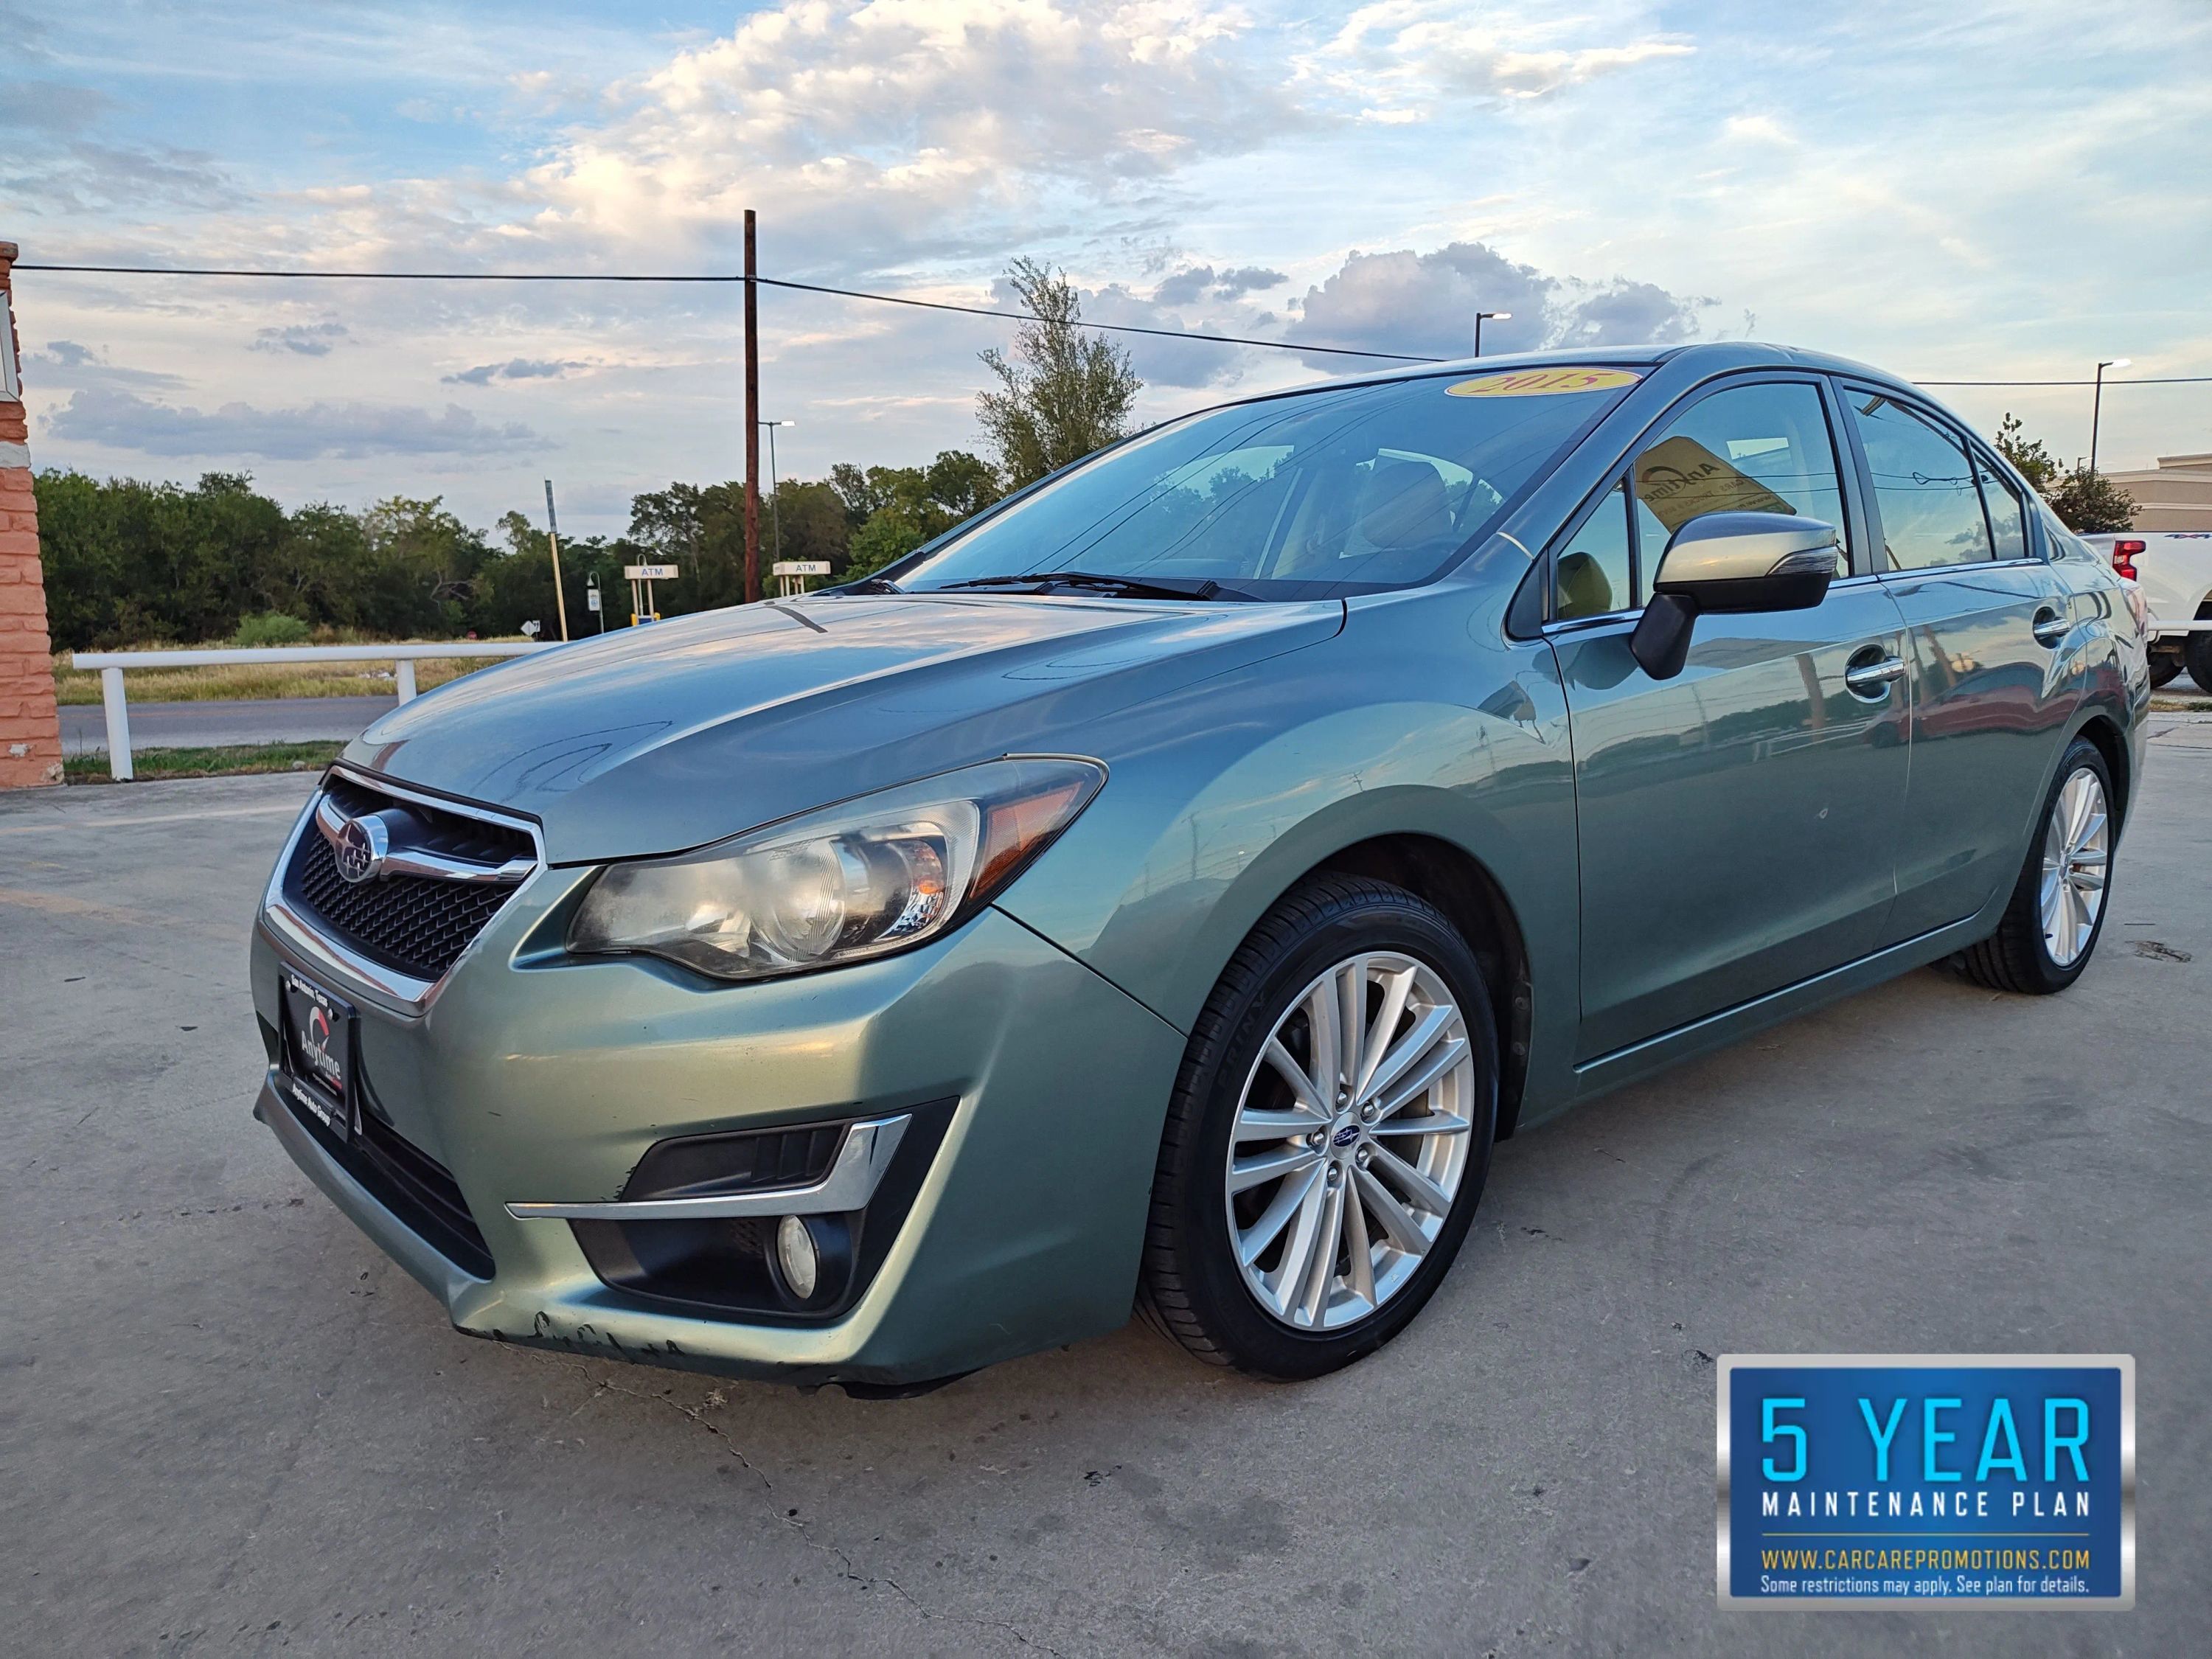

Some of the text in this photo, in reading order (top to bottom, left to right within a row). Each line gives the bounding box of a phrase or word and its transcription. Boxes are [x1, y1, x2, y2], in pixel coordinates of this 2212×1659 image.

[1467, 372, 1617, 394] 2015
[641, 568, 664, 577] ATM
[796, 564, 816, 572] ATM
[302, 1029, 341, 1080] Anytime
